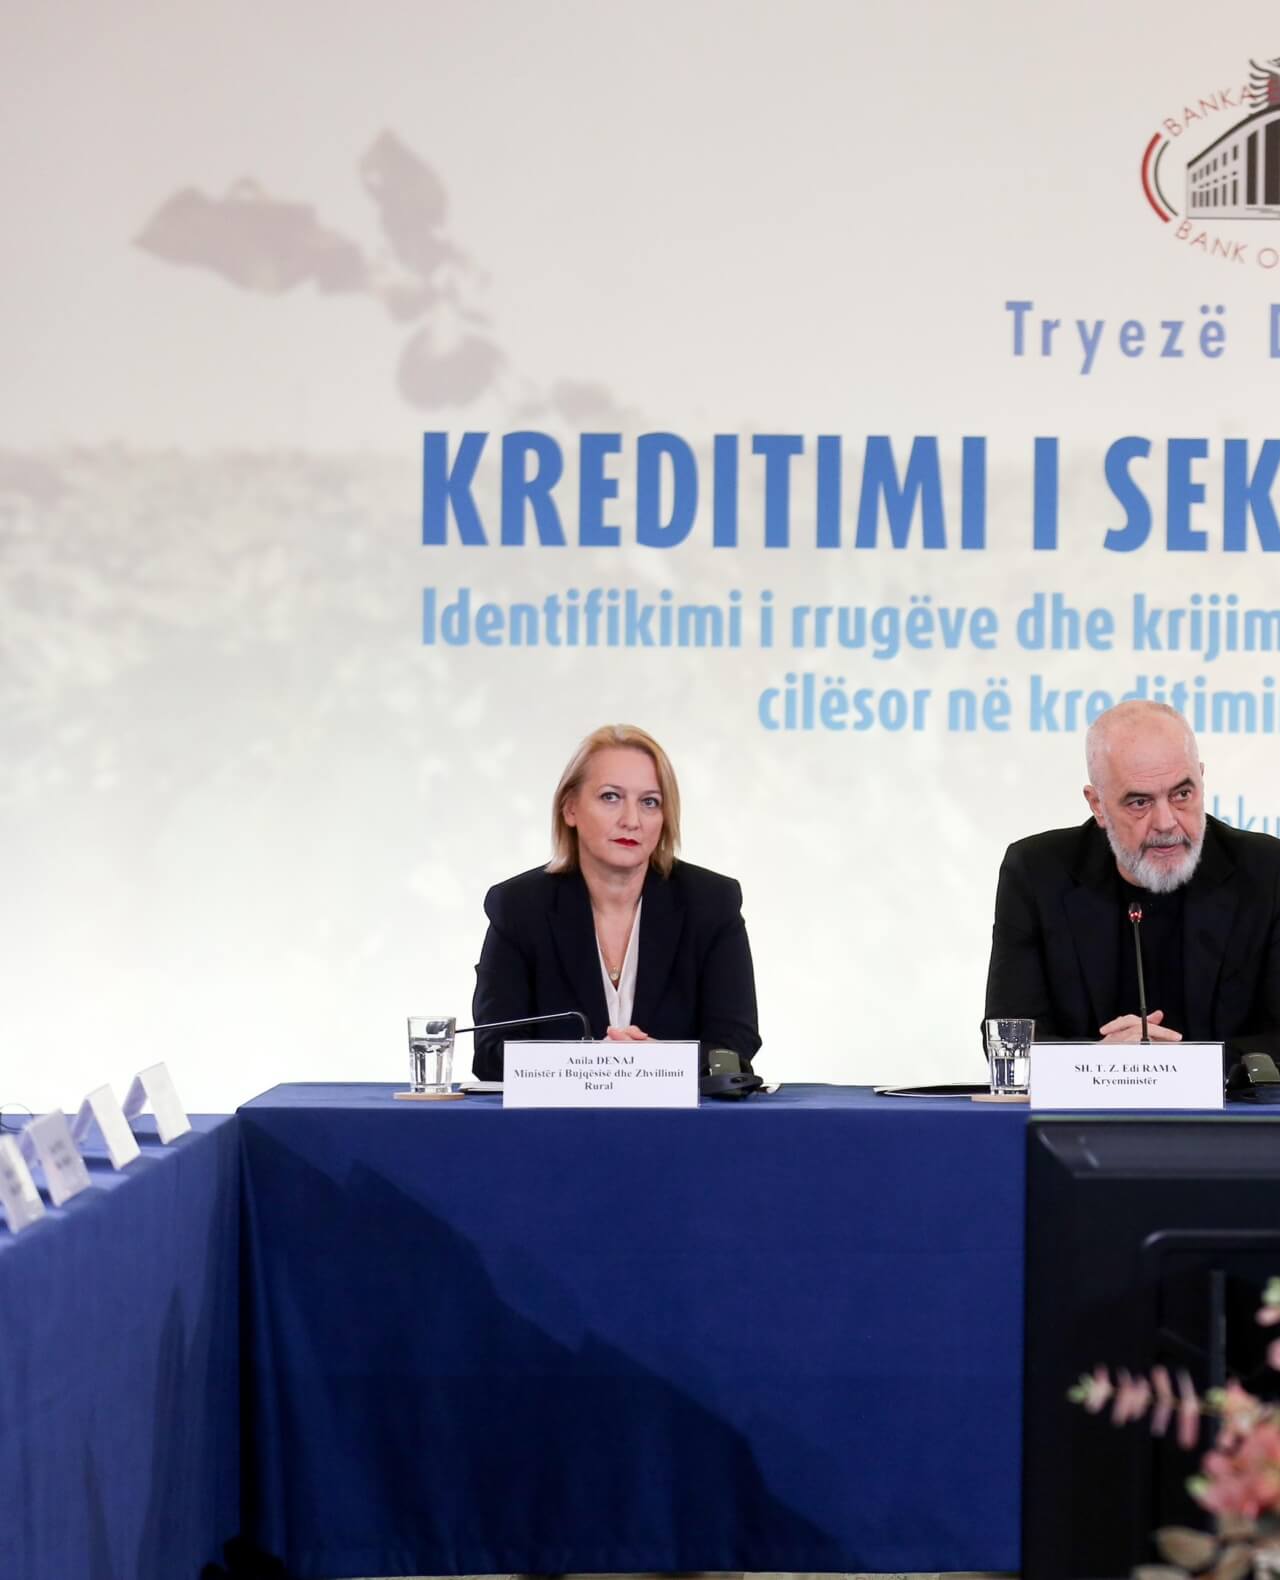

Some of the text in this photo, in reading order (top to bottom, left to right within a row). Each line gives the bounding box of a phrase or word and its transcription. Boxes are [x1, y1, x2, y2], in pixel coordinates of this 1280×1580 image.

[1162, 83, 1256, 138] BANKA
[1174, 220, 1248, 265] BANK
[1005, 301, 1226, 375] Tryezë
[422, 431, 987, 550] KREDITIMI
[1033, 437, 1059, 551] I
[422, 587, 742, 648] Identifikimi
[760, 590, 773, 648] i
[792, 595, 999, 660] rrugëve
[1016, 592, 1115, 651] dhe
[758, 672, 931, 732] cilësor
[948, 677, 1012, 732] në
[514, 1069, 556, 1079] Ministër
[565, 1068, 612, 1080] Bujqësisë
[614, 1068, 633, 1078] dhe
[635, 1068, 684, 1078] Zhvillimit
[567, 1055, 635, 1065] Anila DENAJ
[1074, 1063, 1177, 1073] SH. T. Z. Edi RAMA
[1092, 1076, 1157, 1087] Kryeministër
[585, 1082, 614, 1091] Rural
